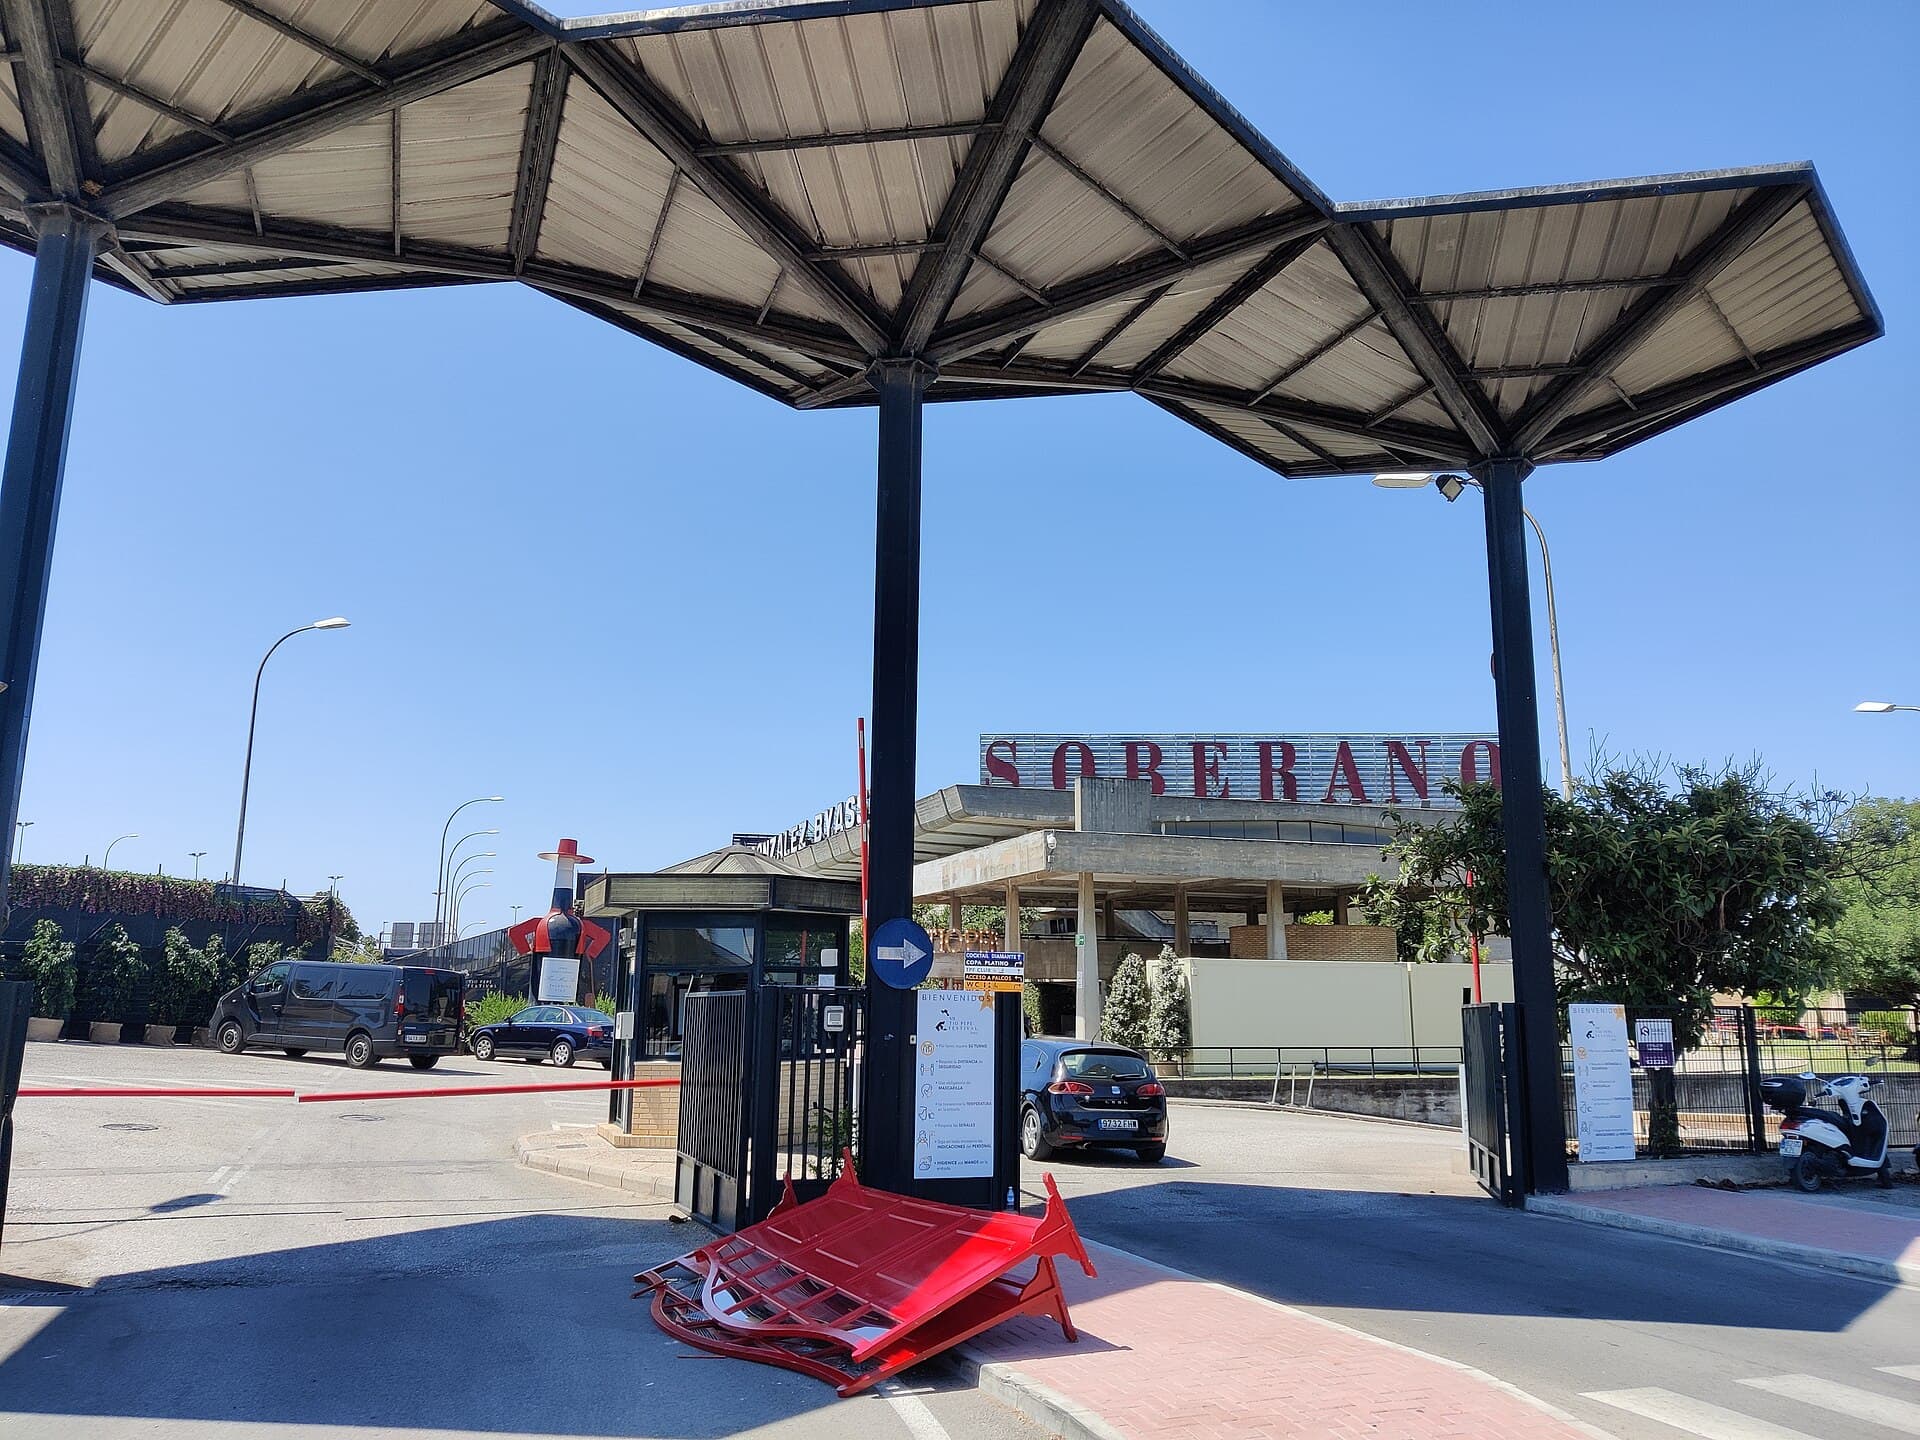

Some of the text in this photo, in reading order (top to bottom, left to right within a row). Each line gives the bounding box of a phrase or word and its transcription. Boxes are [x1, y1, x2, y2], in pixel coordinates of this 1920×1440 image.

[986, 740, 1500, 803] SOBERANO
[752, 820, 808, 860] ONZALEZ
[922, 993, 991, 1002] BIENVENIDOS
